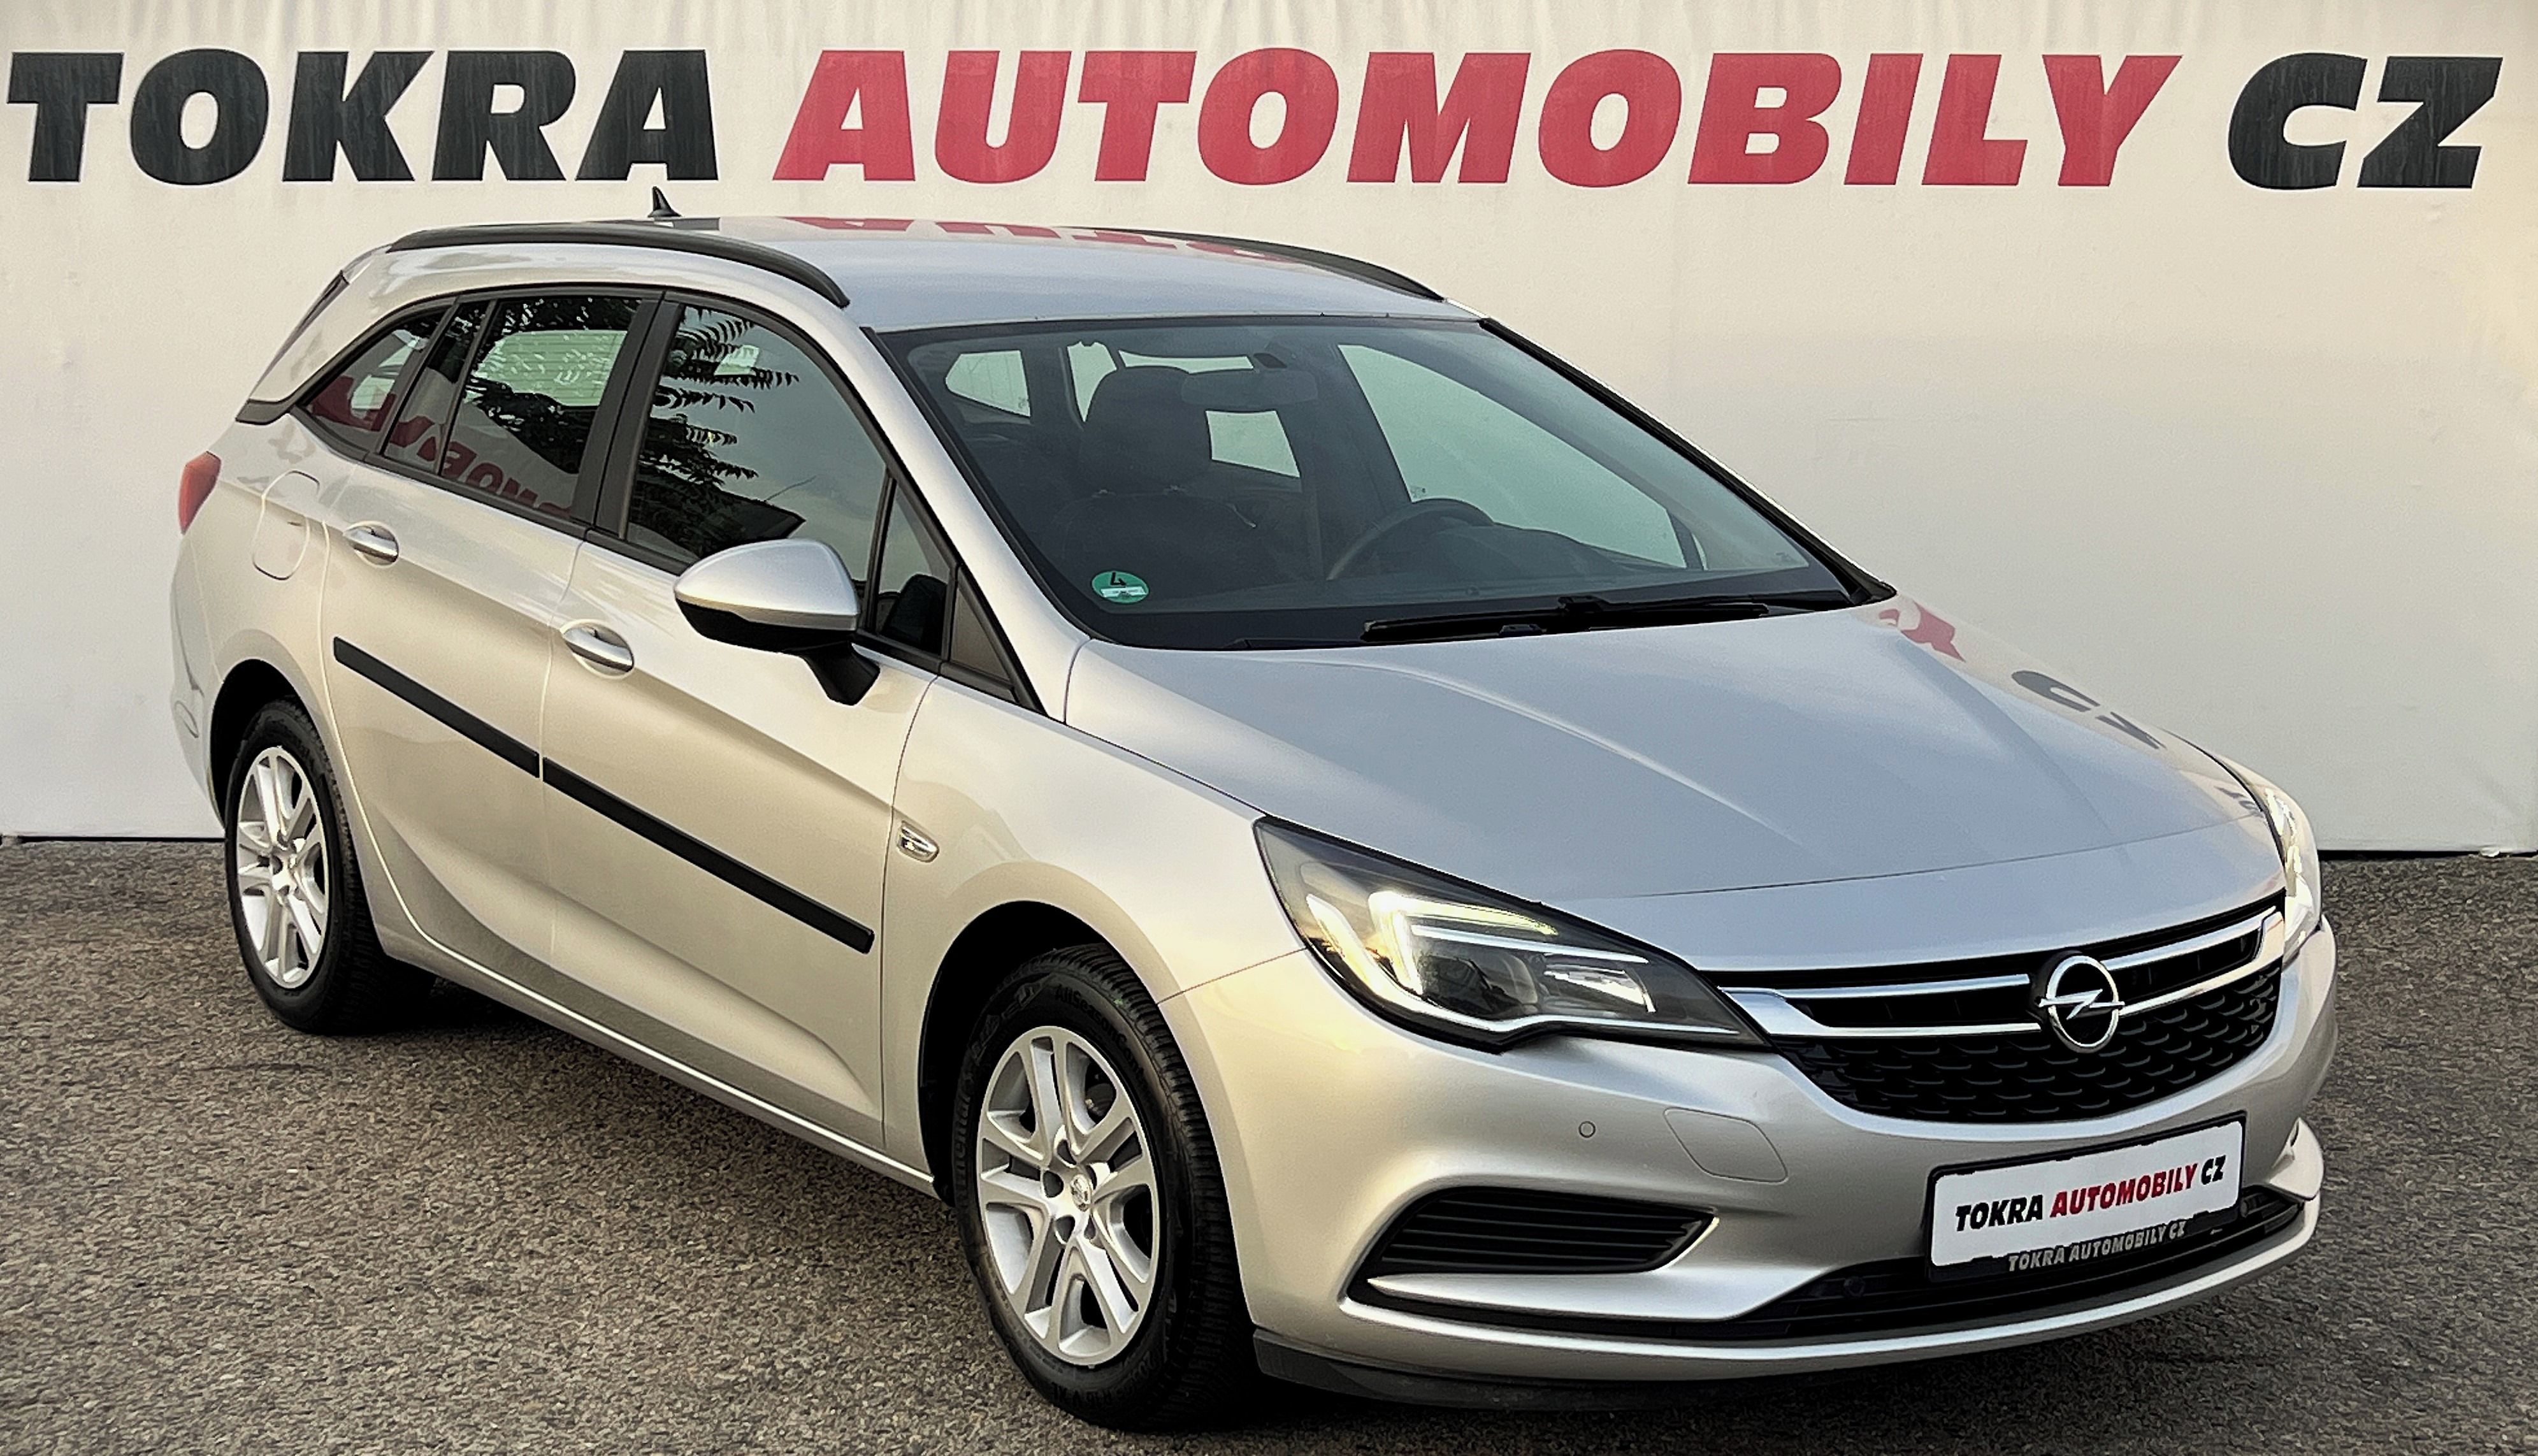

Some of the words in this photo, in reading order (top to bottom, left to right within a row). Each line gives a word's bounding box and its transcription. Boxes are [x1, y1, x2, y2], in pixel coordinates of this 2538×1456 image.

[6, 48, 719, 186] TOKRA
[772, 48, 2182, 188] AUTOMOBILY
[2228, 52, 2504, 191] CZ
[1955, 1194, 2044, 1232] TOKRA
[2049, 1163, 2199, 1218] AUTOMOBILY
[2201, 1155, 2226, 1185] CZ
[2008, 1247, 2065, 1272] TOKRA
[2068, 1225, 2167, 1262] AUTOMOBILY
[2169, 1220, 2186, 1240] CZ
